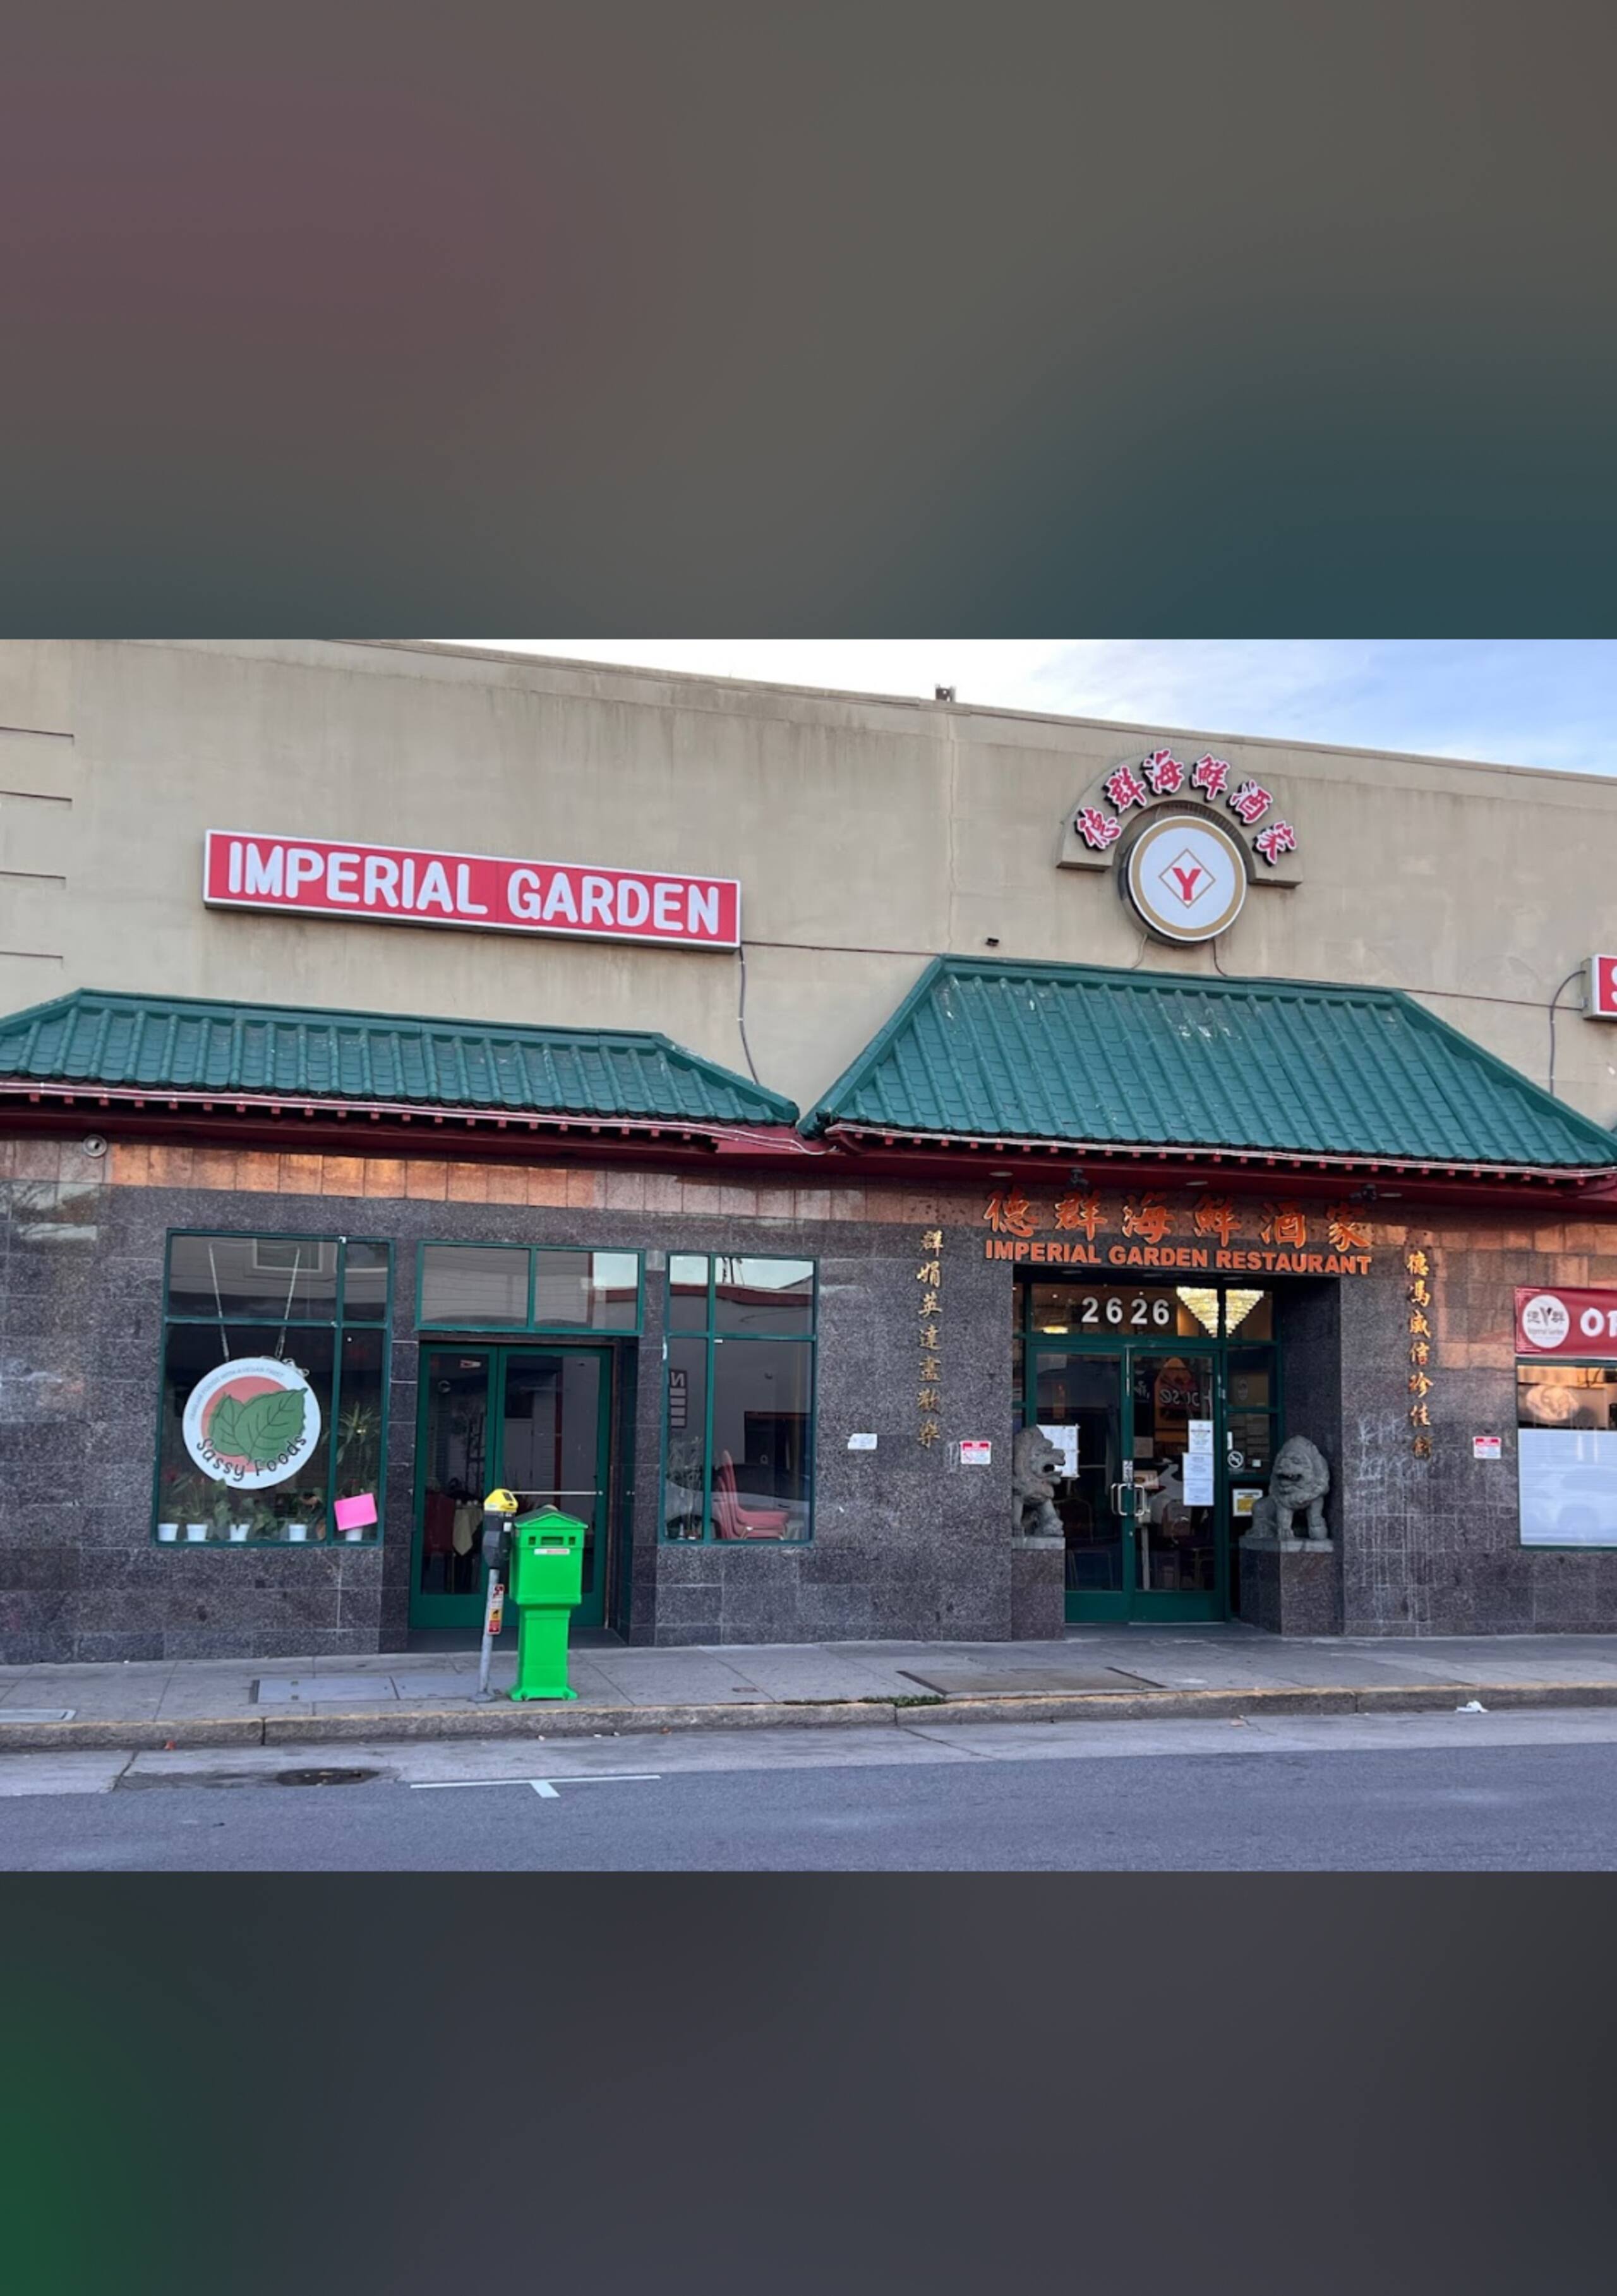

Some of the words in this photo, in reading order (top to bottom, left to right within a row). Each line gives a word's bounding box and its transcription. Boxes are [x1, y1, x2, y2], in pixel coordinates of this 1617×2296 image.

[228, 841, 488, 914] IMPERIAL
[507, 869, 719, 935] GARDEN
[1172, 867, 1202, 902] Y
[985, 1239, 1101, 1264] IMPERIAL
[1109, 1245, 1208, 1268] GARDEN
[1216, 1249, 1372, 1275] RESTAURANT
[1081, 1297, 1170, 1325] 2626
[196, 1438, 245, 1482] Sassy
[254, 1435, 306, 1477] Foods
